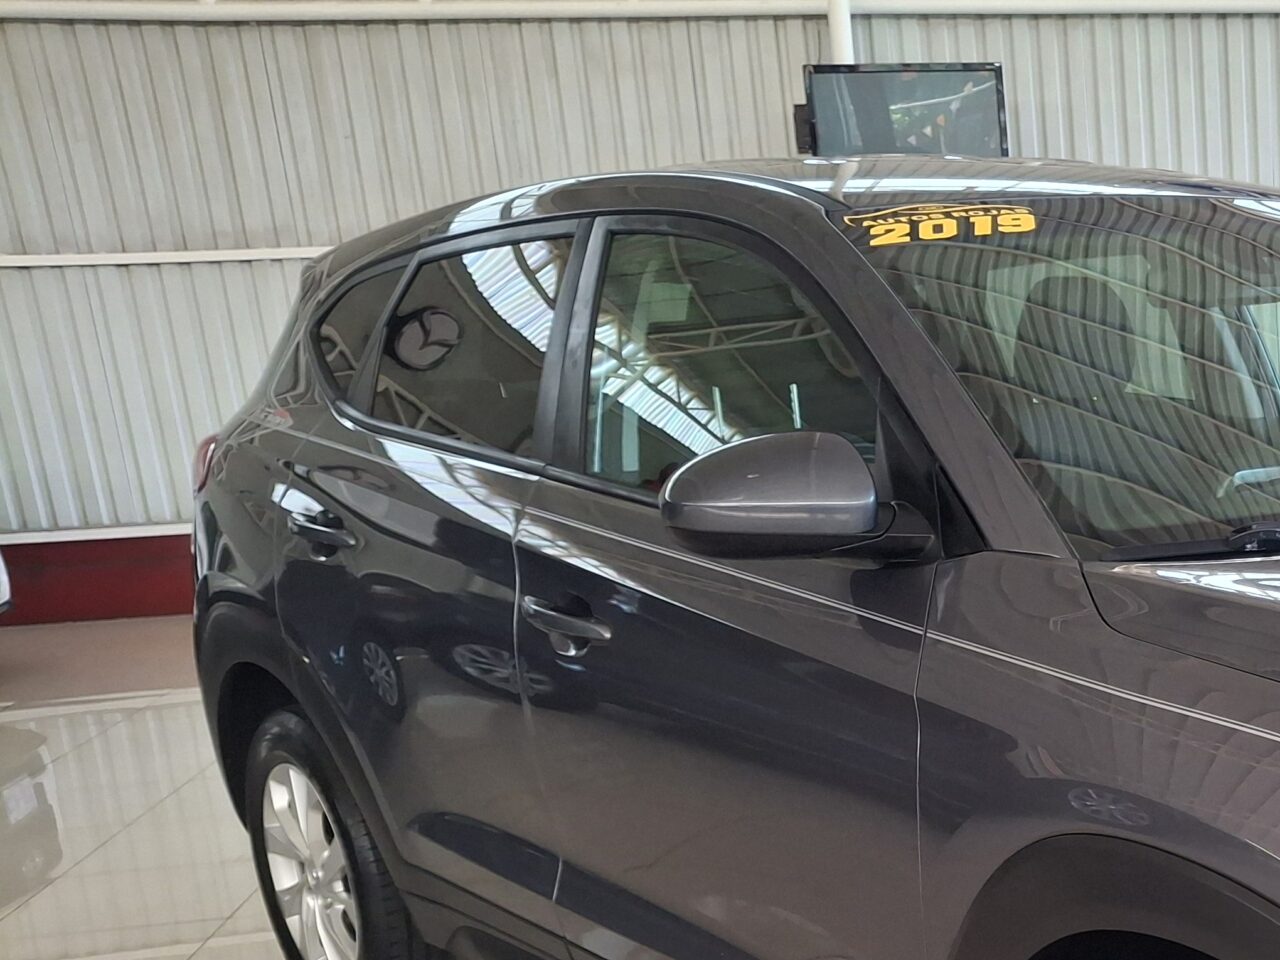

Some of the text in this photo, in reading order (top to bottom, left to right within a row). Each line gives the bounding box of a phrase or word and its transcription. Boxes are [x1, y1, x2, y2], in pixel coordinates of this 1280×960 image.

[862, 213, 945, 227] AUTOS
[951, 208, 1030, 218] ROJAS
[869, 213, 1037, 247] 2019
